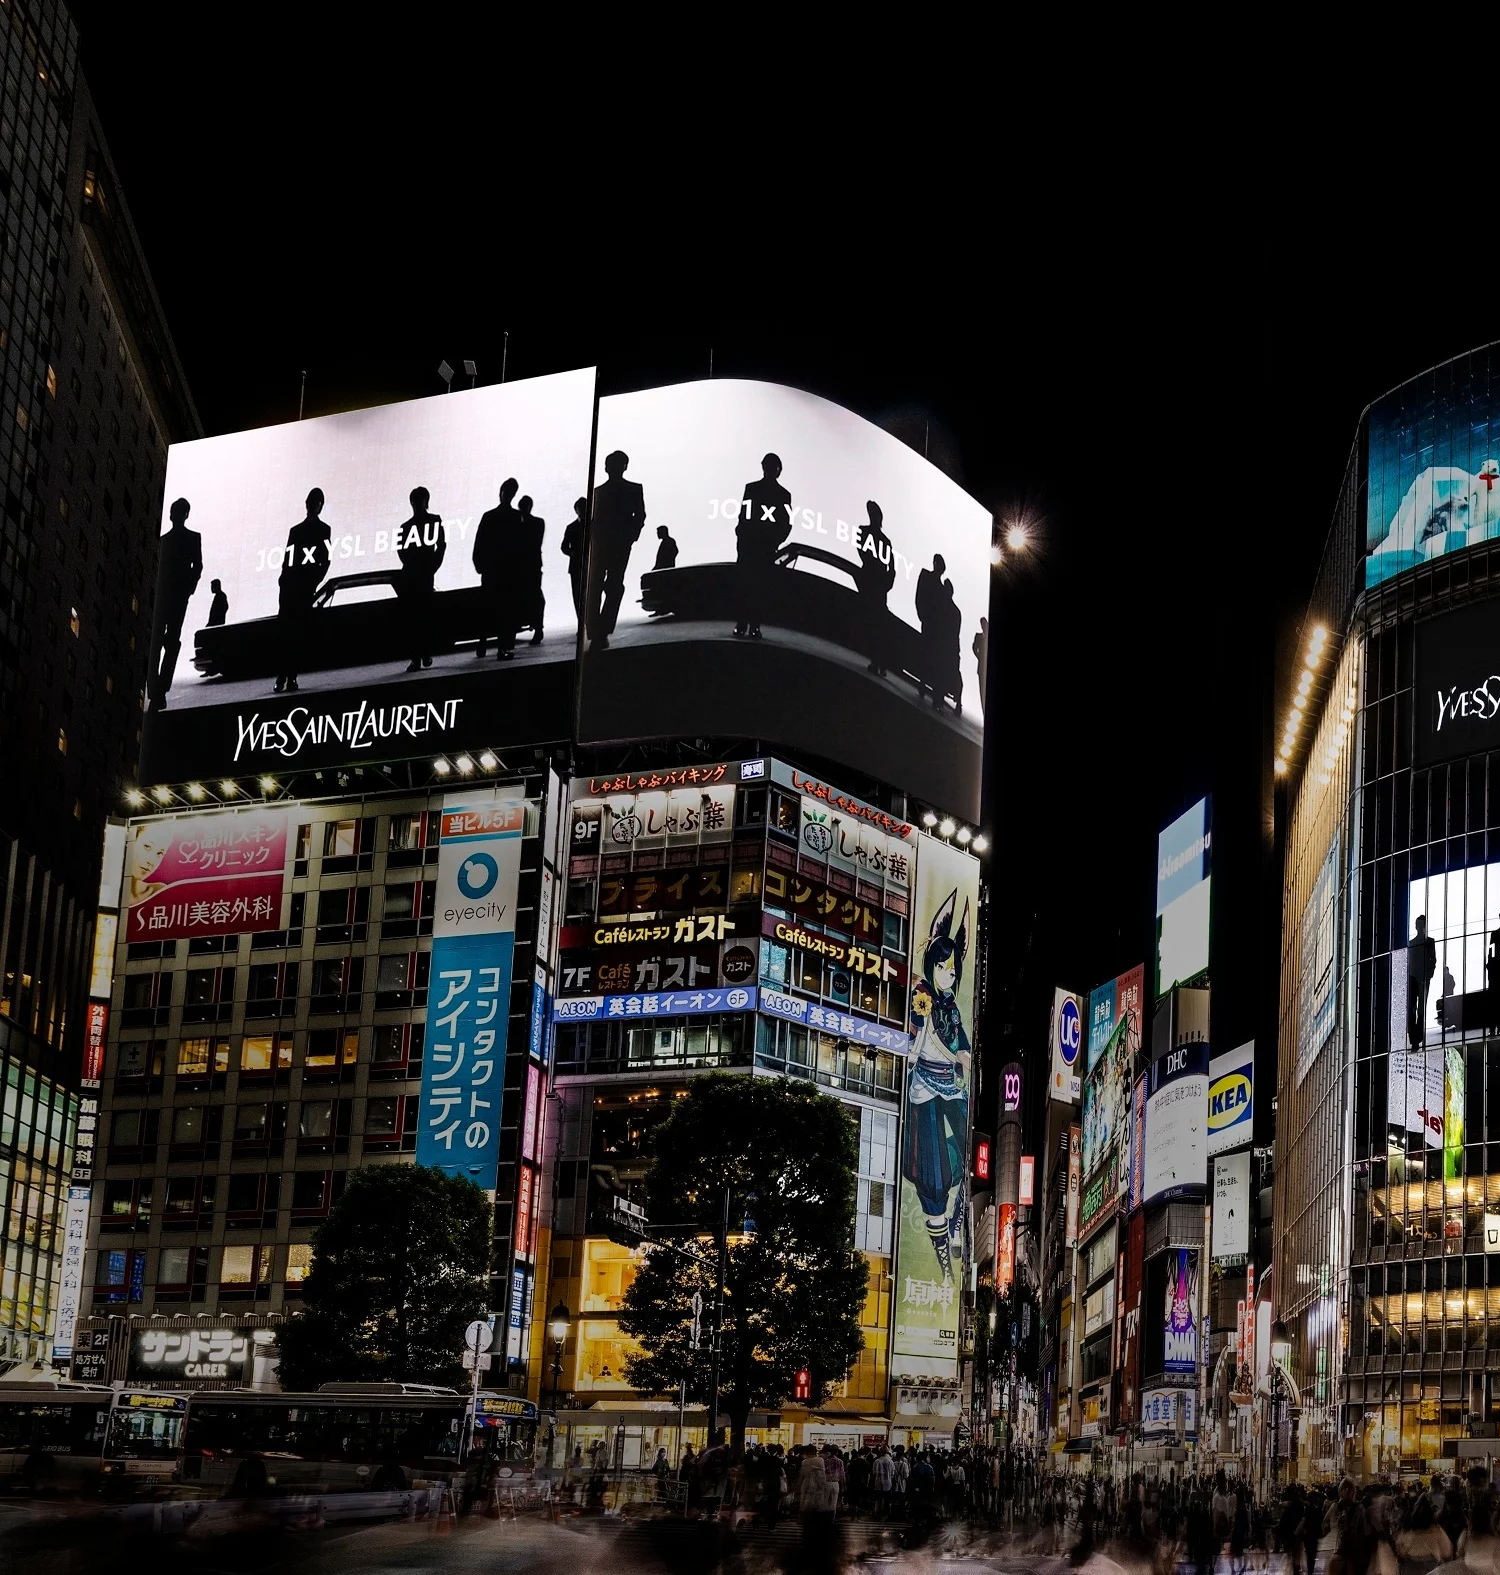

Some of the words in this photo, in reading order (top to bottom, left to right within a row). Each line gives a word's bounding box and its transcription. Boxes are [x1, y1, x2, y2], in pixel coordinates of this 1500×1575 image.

[256, 545, 295, 573] JO1
[324, 535, 367, 561] YSL
[374, 515, 474, 552] BEAUTY
[707, 498, 753, 520] JO1
[783, 502, 829, 536] YSL
[835, 518, 915, 581] BEAUTY
[590, 764, 728, 794] しゃぶしゃぶバイキング
[648, 802, 725, 834] しゃぶ葉
[793, 770, 913, 839] しゃぶしゃぶバイキング
[449, 809, 517, 834] 当ビル5F
[574, 820, 598, 839] 9F
[200, 846, 270, 870] クリニック
[840, 830, 908, 881] しゃぶ葉
[148, 895, 273, 930] 品川美容外科
[444, 902, 507, 926] eyecity
[765, 868, 879, 933] コンタクト
[674, 915, 736, 943] ガスト
[563, 967, 592, 988] 7F
[598, 963, 632, 980] Café
[634, 956, 711, 991] ガスト
[847, 946, 898, 983] ガスト
[559, 1001, 598, 1018] AEON
[609, 993, 722, 1016] 英会話イーオン
[729, 992, 745, 1006] 6F
[766, 993, 802, 1017] AEON
[810, 1006, 907, 1049] 英会話イーオン
[428, 968, 473, 1151] アイシティ
[463, 967, 500, 1149] コンタクトの
[1166, 1049, 1188, 1075] DHC
[1004, 1074, 1020, 1111] 109
[980, 1146, 988, 1157] UNI
[74, 1170, 89, 1178] 5F
[979, 1162, 988, 1175] QLO
[902, 1275, 955, 1324] 原神
[78, 1332, 91, 1347] 薬
[75, 1354, 106, 1365] 処方せん
[82, 1367, 98, 1378] 受付
